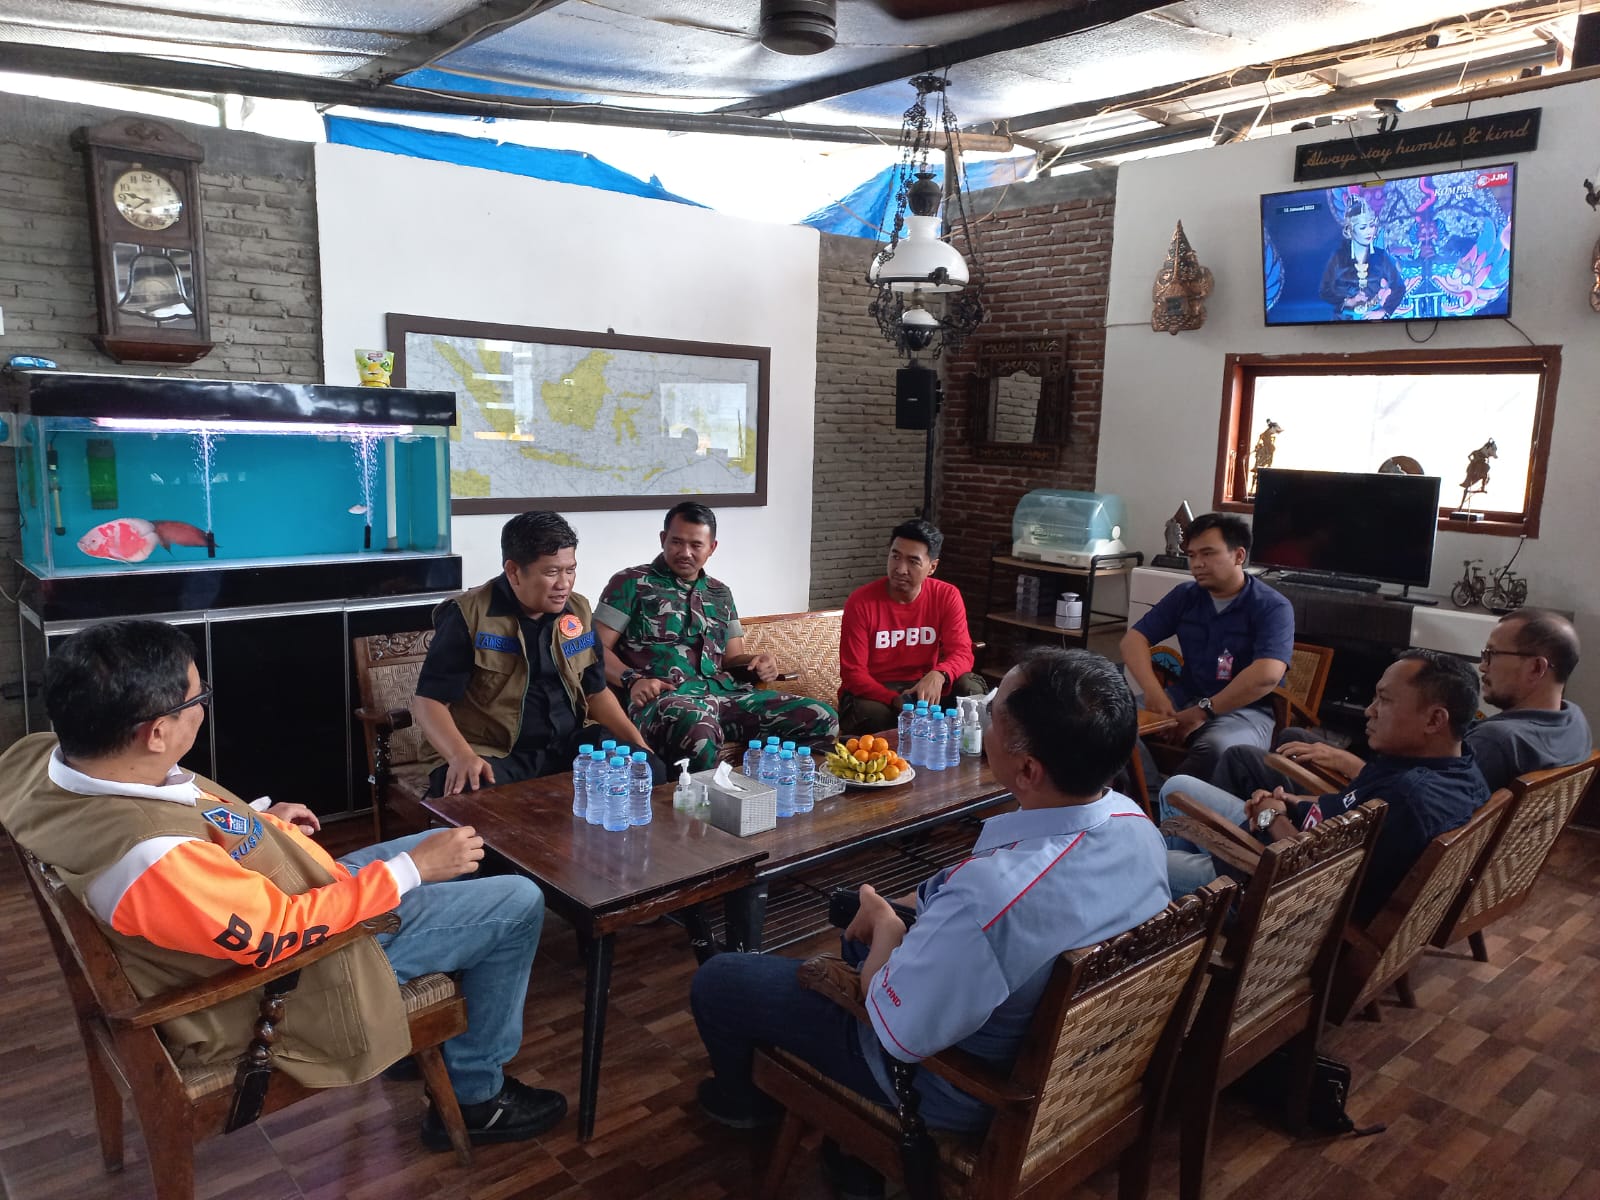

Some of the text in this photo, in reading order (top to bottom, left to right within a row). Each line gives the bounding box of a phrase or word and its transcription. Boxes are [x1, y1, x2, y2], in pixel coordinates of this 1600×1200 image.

[1303, 151, 1357, 169] Always
[1397, 132, 1456, 154] humble
[1463, 127, 1481, 145] &
[1485, 118, 1529, 142] kind
[1490, 173, 1508, 182] JJM
[1434, 185, 1473, 197] KOMPAS
[875, 626, 937, 649] BPBD
